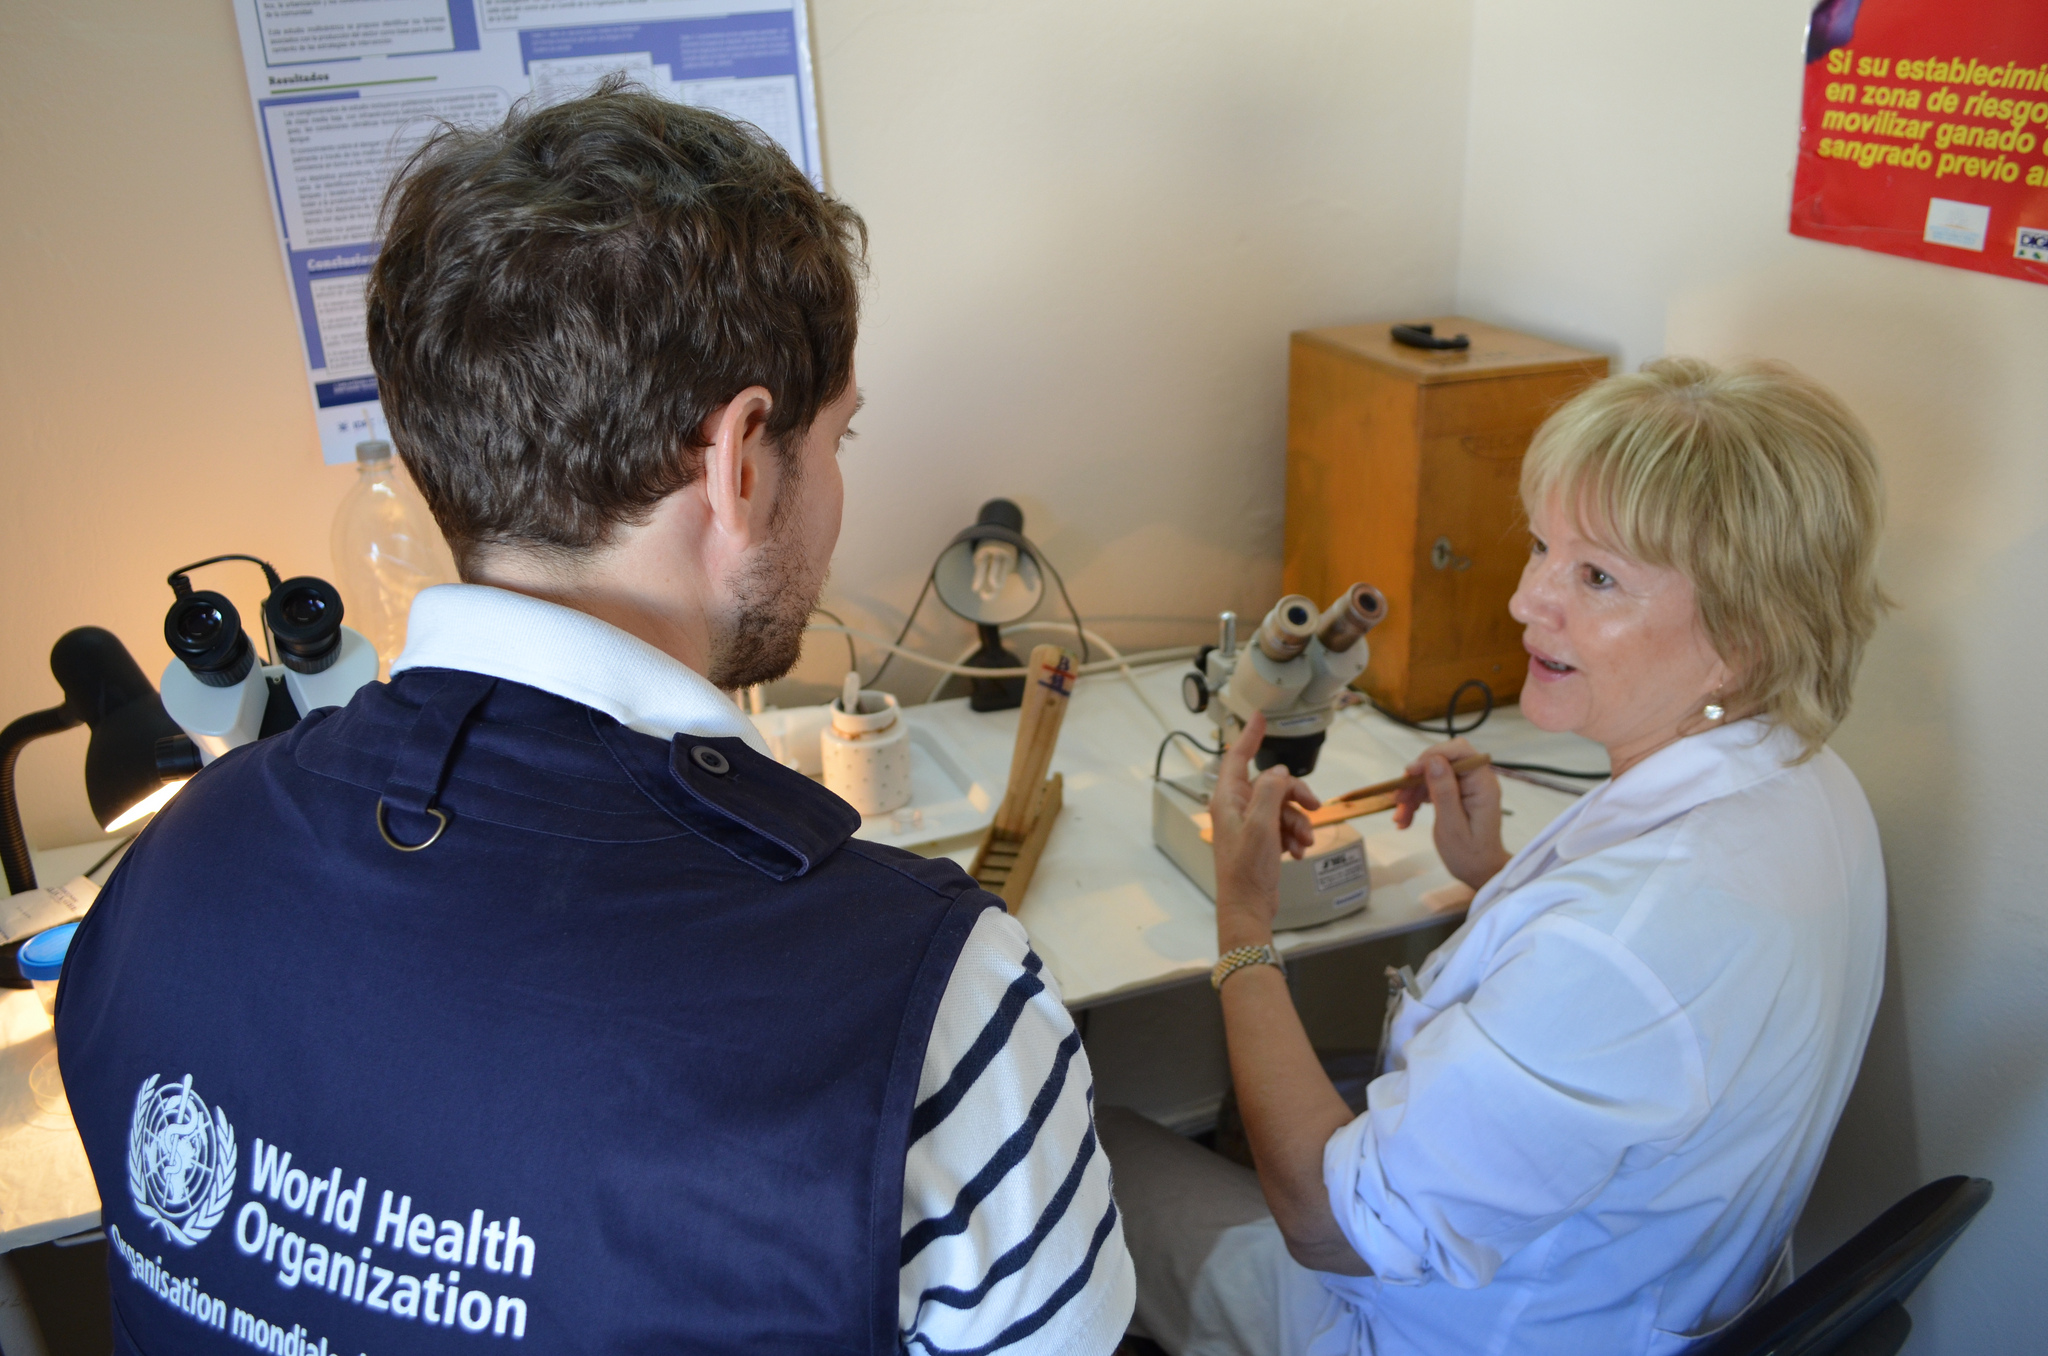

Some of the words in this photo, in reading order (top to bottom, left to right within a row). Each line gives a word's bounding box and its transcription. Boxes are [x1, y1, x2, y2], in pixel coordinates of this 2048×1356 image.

[1826, 48, 1854, 75] Si
[1856, 55, 1891, 78] su
[1825, 82, 1857, 103] en
[1861, 85, 1922, 110] zona
[1926, 86, 1960, 115] de
[1821, 109, 1933, 141] movilizar
[1935, 122, 2036, 154] ganado
[1817, 137, 1933, 170] sangrado
[1935, 153, 2020, 183] previo
[251, 1137, 367, 1234] World
[374, 1189, 536, 1277] Health
[109, 1223, 227, 1329] Organisation
[231, 1307, 339, 1356] mondial
[236, 1201, 528, 1339] Organization
